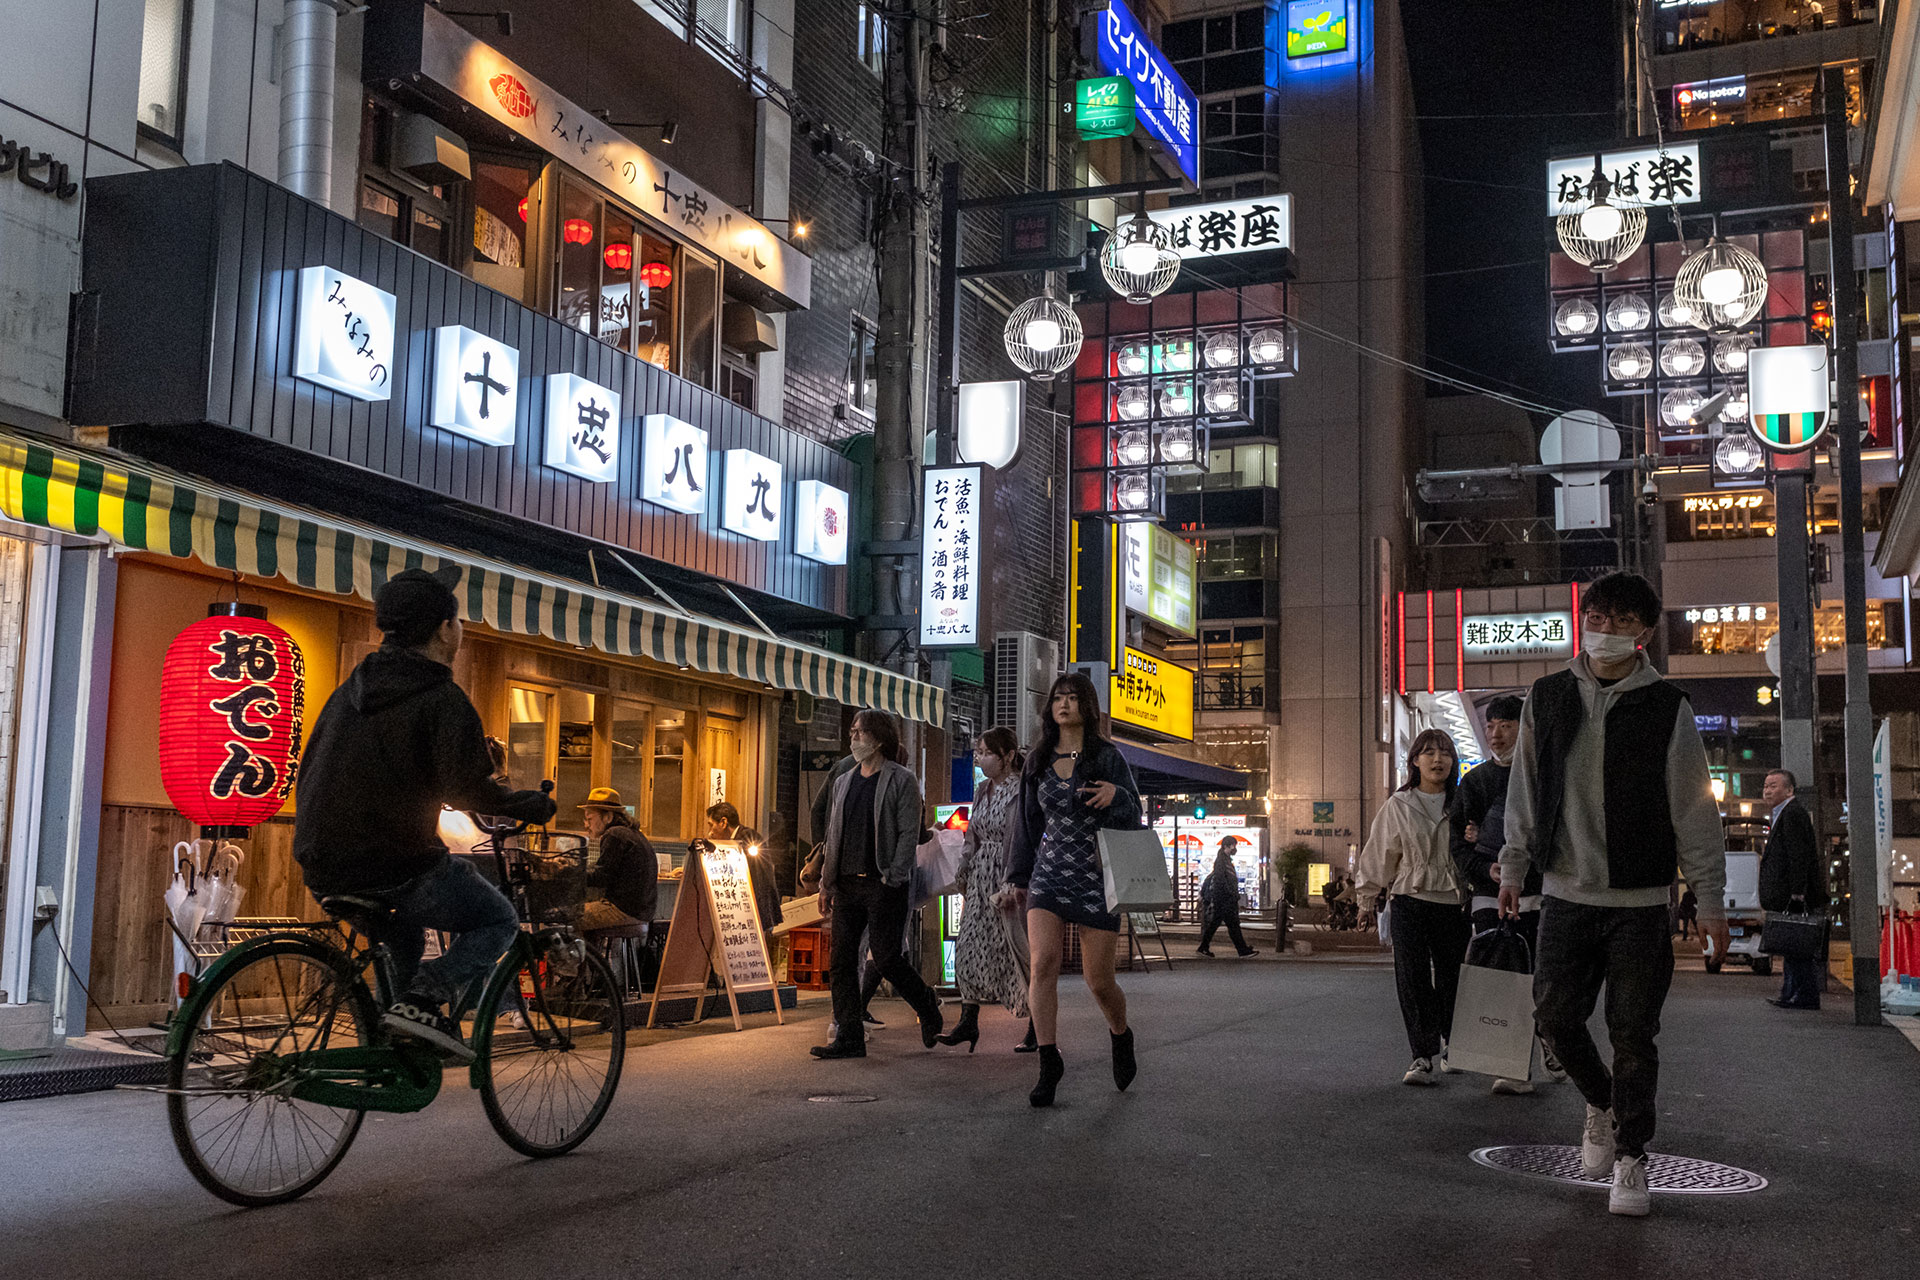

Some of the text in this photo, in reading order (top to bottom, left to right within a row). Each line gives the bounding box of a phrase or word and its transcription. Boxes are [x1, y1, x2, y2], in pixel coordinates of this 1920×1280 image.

[1107, 0, 1191, 144] セイワ不動産
[1087, 83, 1119, 97] レイク
[1063, 102, 1072, 113] 3
[1101, 118, 1117, 128] 入口
[1557, 153, 1693, 203] なば楽
[327, 280, 388, 388] みなみの
[930, 478, 949, 601] おでん・酒の肴
[952, 477, 973, 601] 活魚・海鮮料理
[1466, 619, 1566, 646] 難波本通
[1483, 646, 1553, 656] NAMBA HONDORI
[209, 630, 281, 799] おでん
[1222, 817, 1244, 827] Shop
[1479, 1015, 1508, 1028] IQOS
